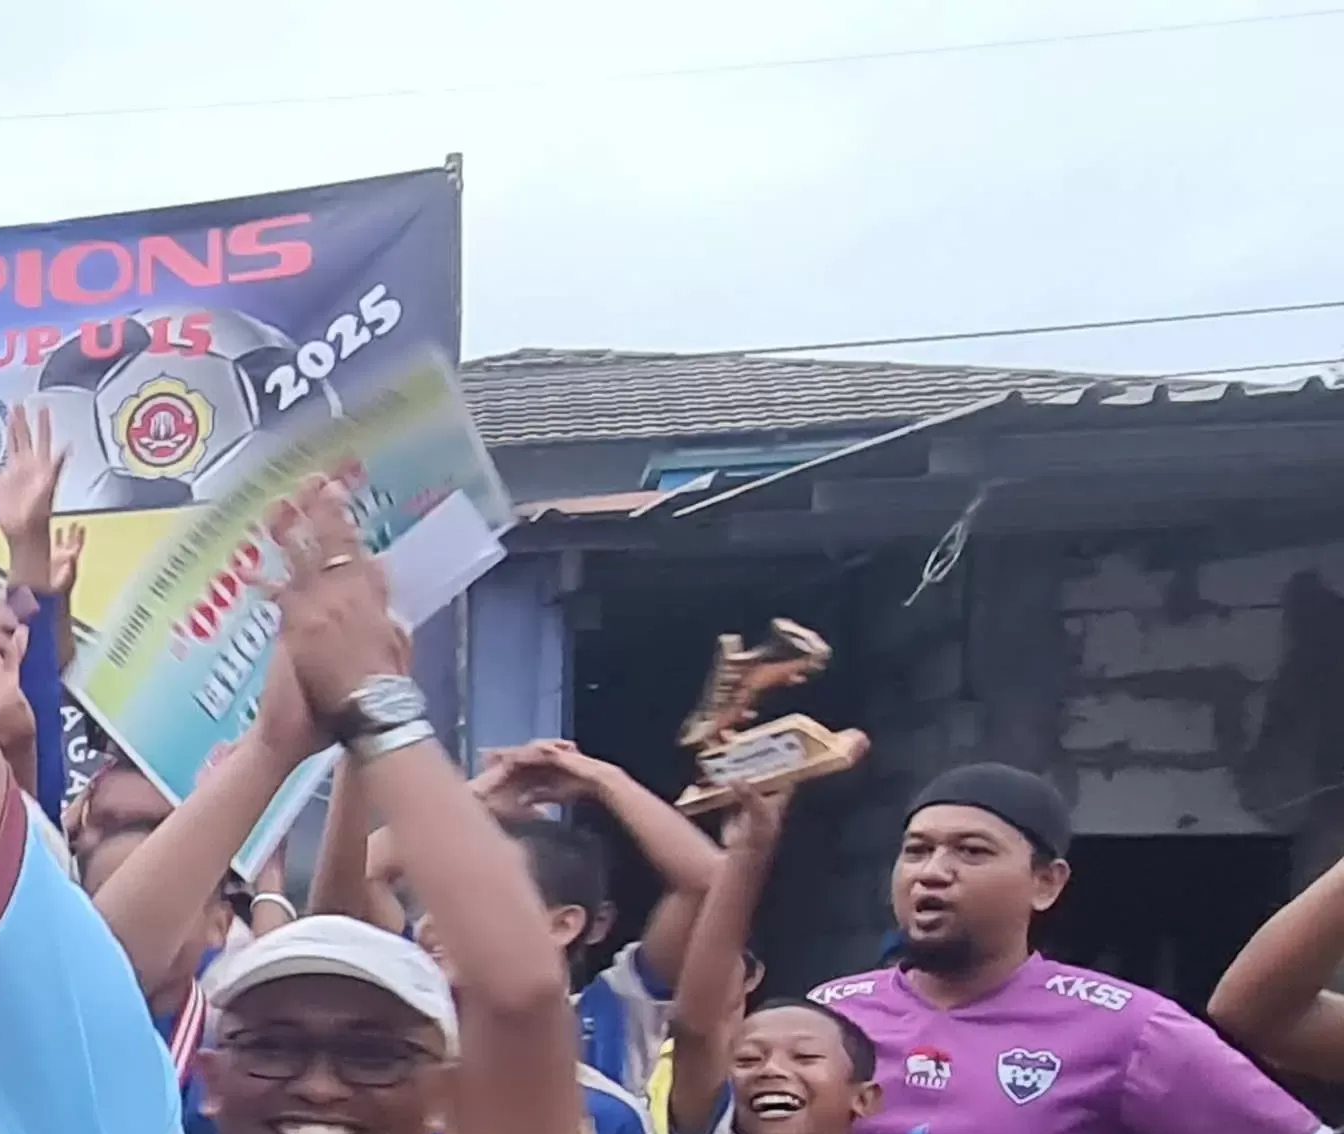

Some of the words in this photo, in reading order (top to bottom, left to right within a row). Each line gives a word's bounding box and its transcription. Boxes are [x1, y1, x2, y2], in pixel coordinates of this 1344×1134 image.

[80, 318, 127, 360] U
[150, 312, 214, 360] 15
[264, 283, 404, 412] 2025
[1045, 974, 1132, 1011] KKSS
